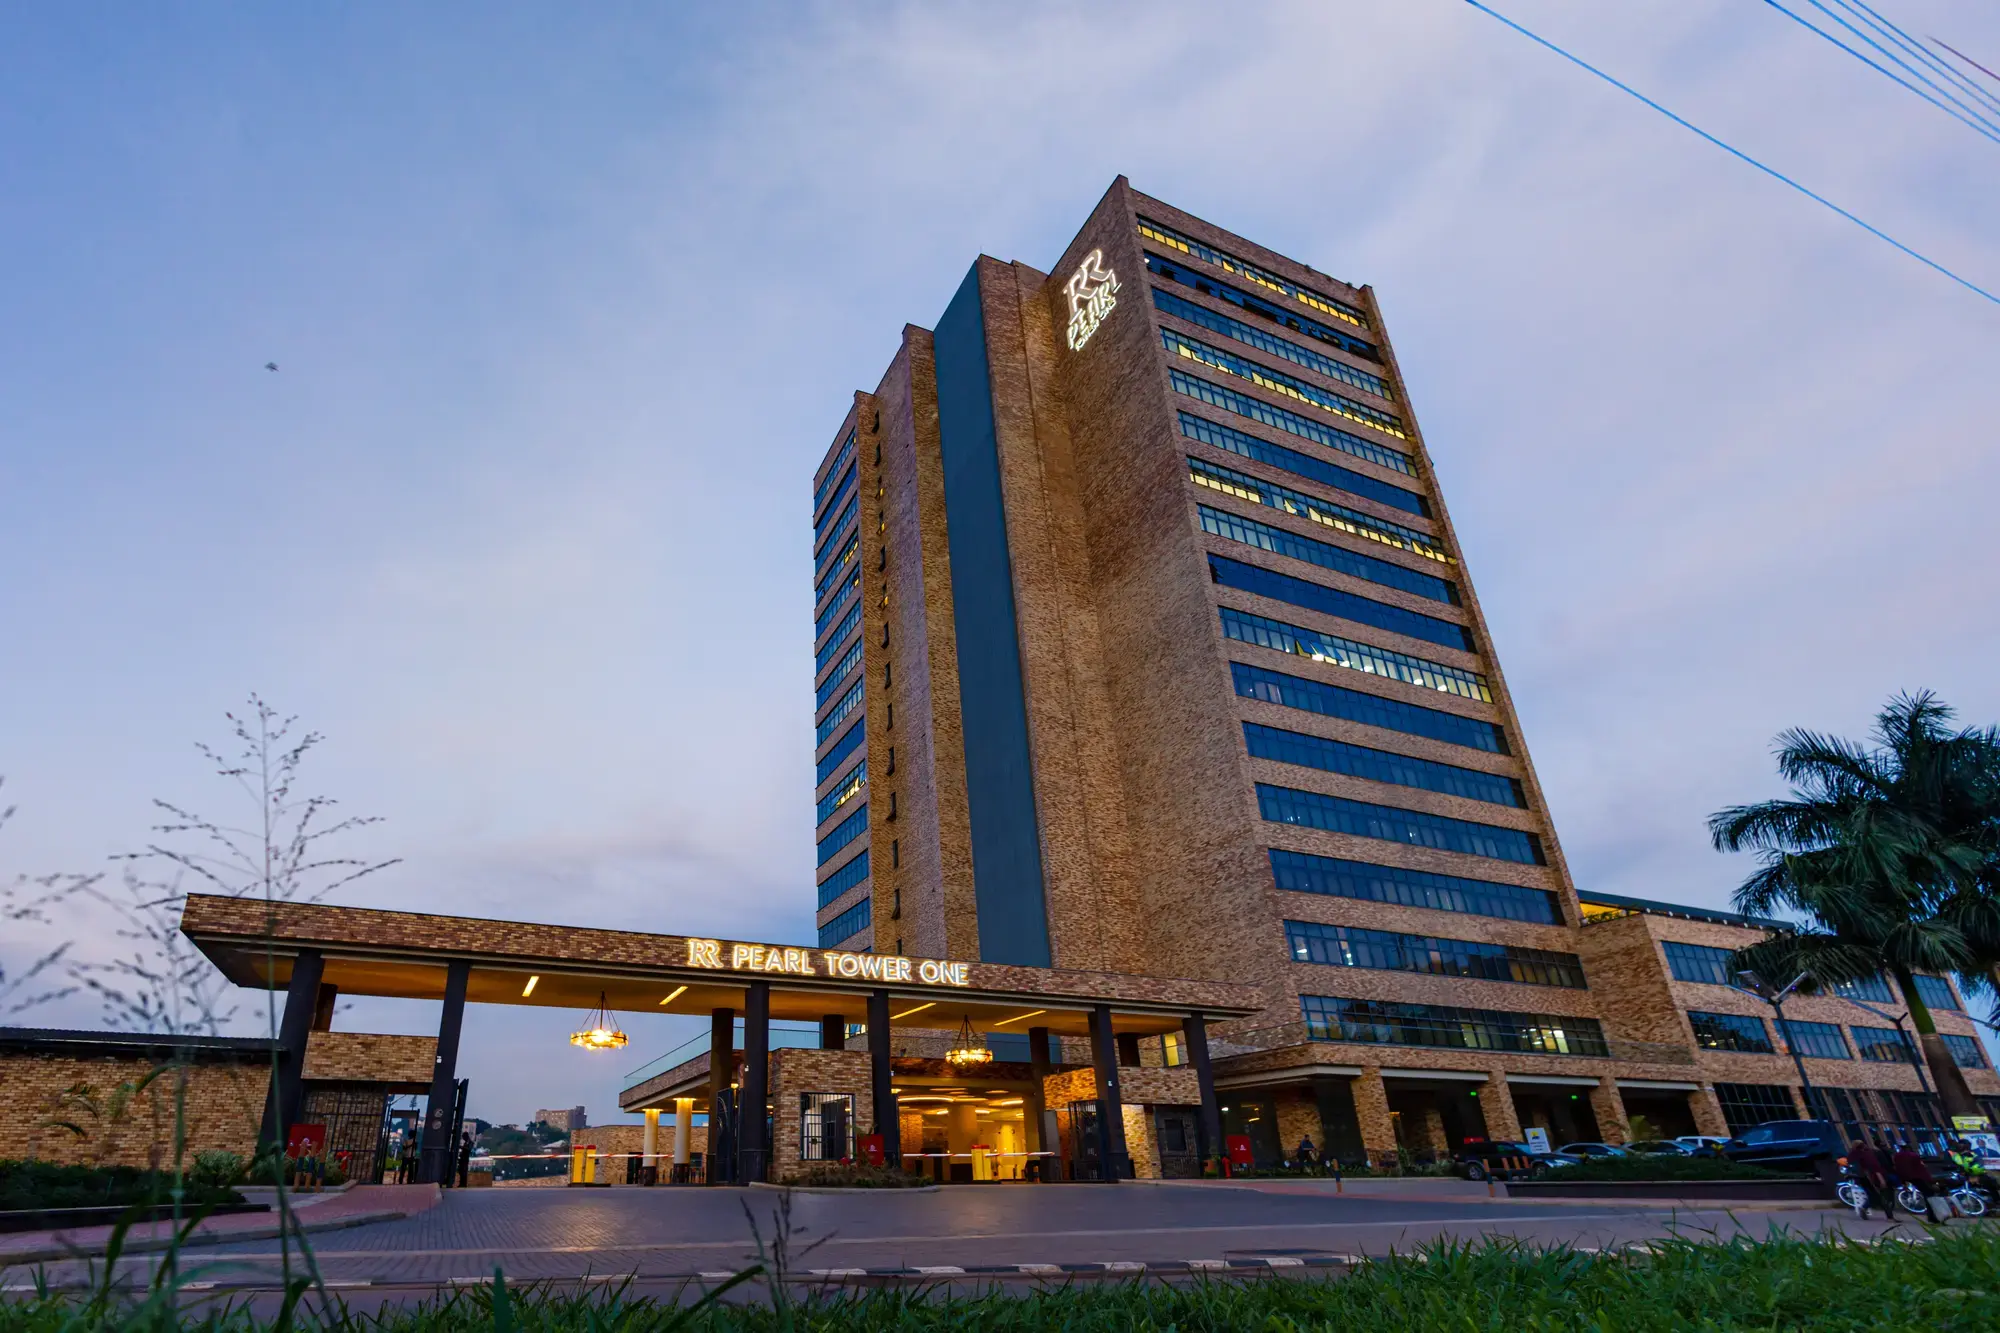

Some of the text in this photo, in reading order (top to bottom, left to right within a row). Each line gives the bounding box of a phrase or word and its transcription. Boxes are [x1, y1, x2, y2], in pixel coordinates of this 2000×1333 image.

[1067, 271, 1122, 350] PEARL
[687, 938, 969, 985] RR PEARL TOWER ONE
